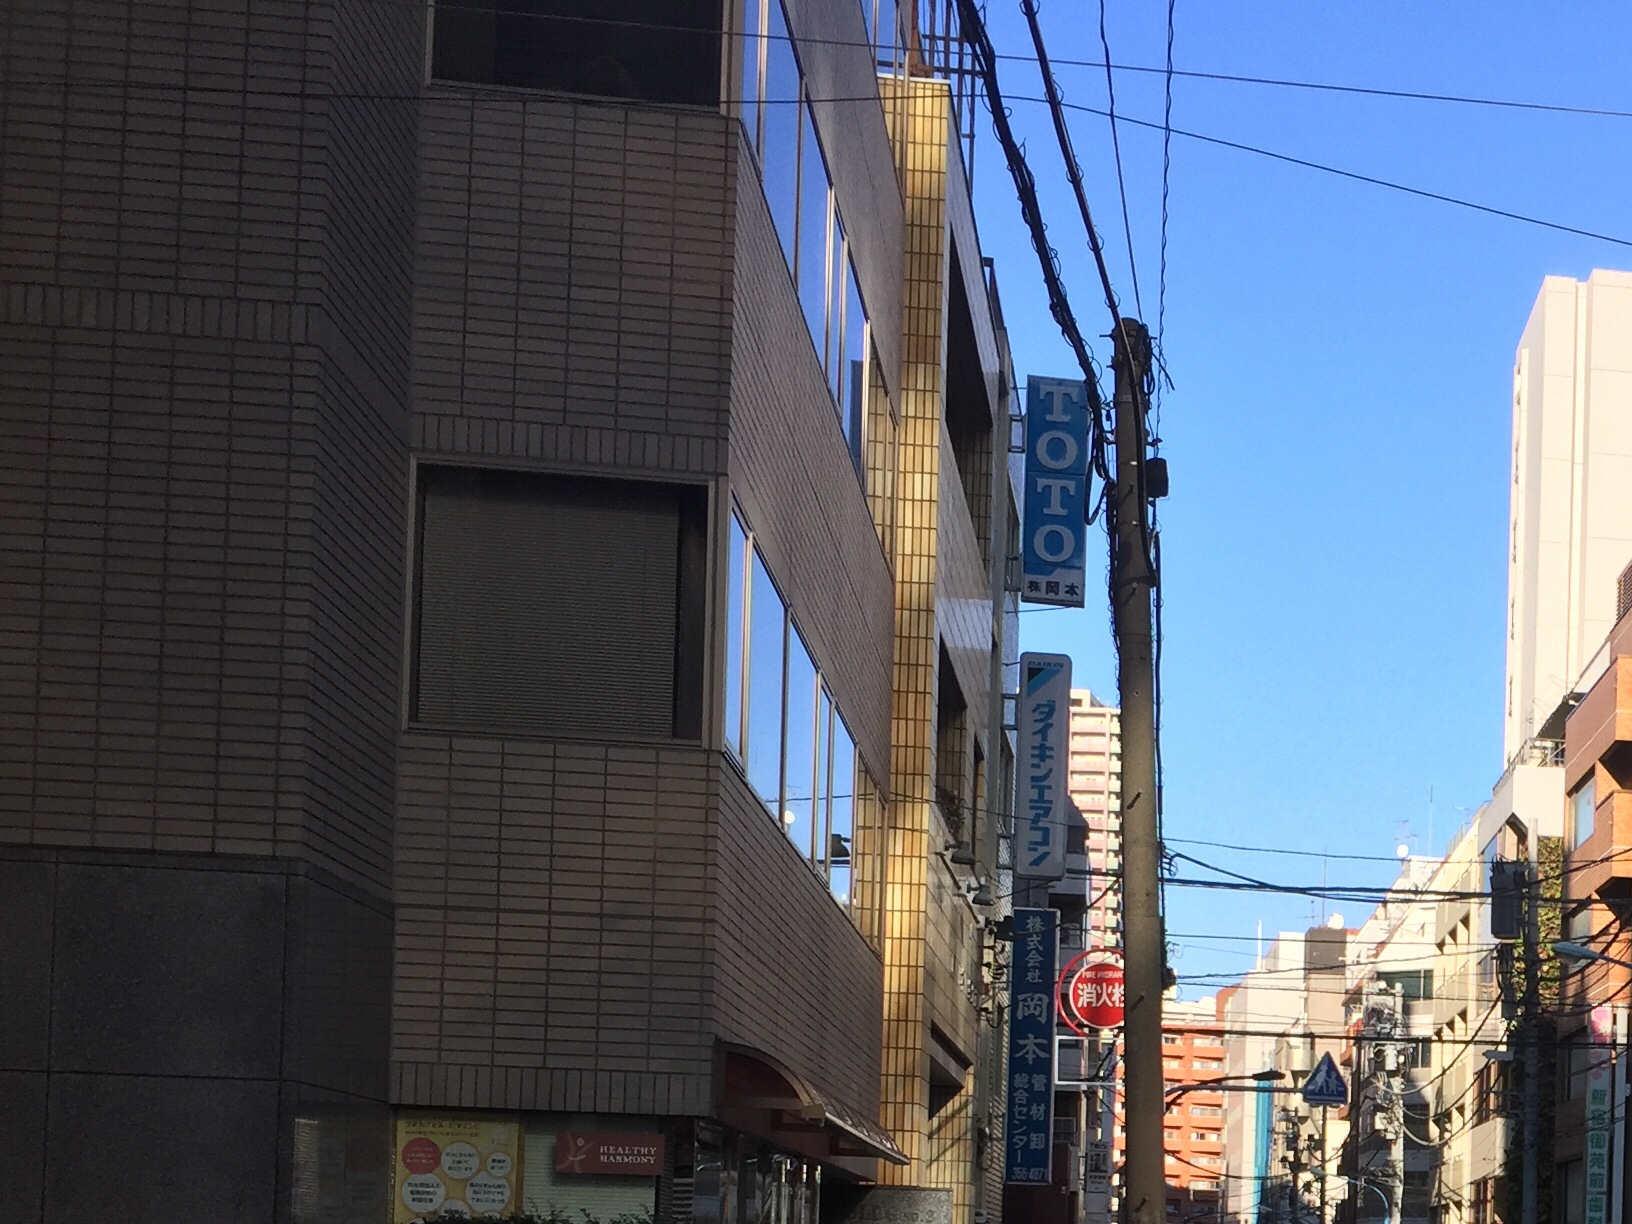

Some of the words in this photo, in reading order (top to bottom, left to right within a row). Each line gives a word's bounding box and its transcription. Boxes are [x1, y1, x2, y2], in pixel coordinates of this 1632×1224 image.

[1033, 384, 1079, 564] TOTO
[1028, 700, 1057, 867] ダイキンエアコン
[599, 1145, 658, 1155] HEALTHY
[1029, 1072, 1047, 1151] 管材卸
[599, 1154, 657, 1164] HARMONY
